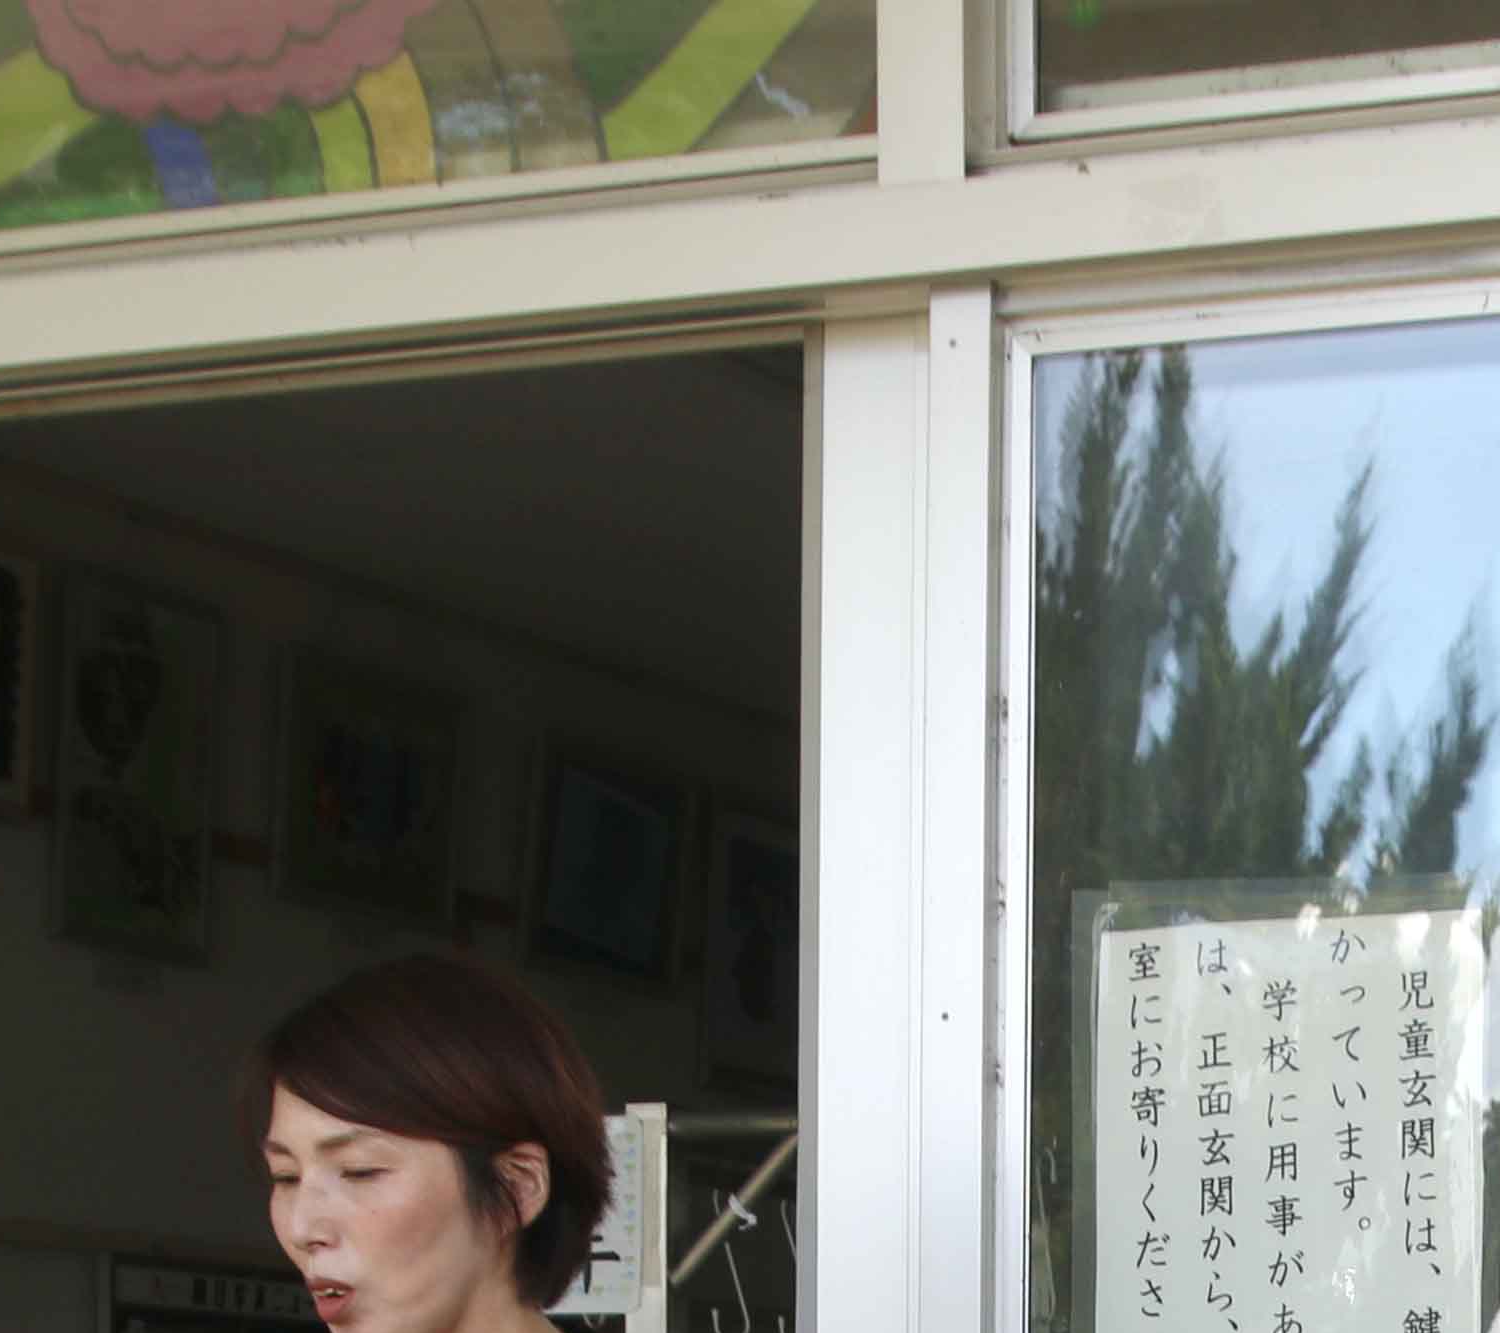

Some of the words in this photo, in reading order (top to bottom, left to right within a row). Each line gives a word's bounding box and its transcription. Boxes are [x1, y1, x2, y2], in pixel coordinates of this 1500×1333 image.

[1330, 929, 1372, 1233] かっています。
